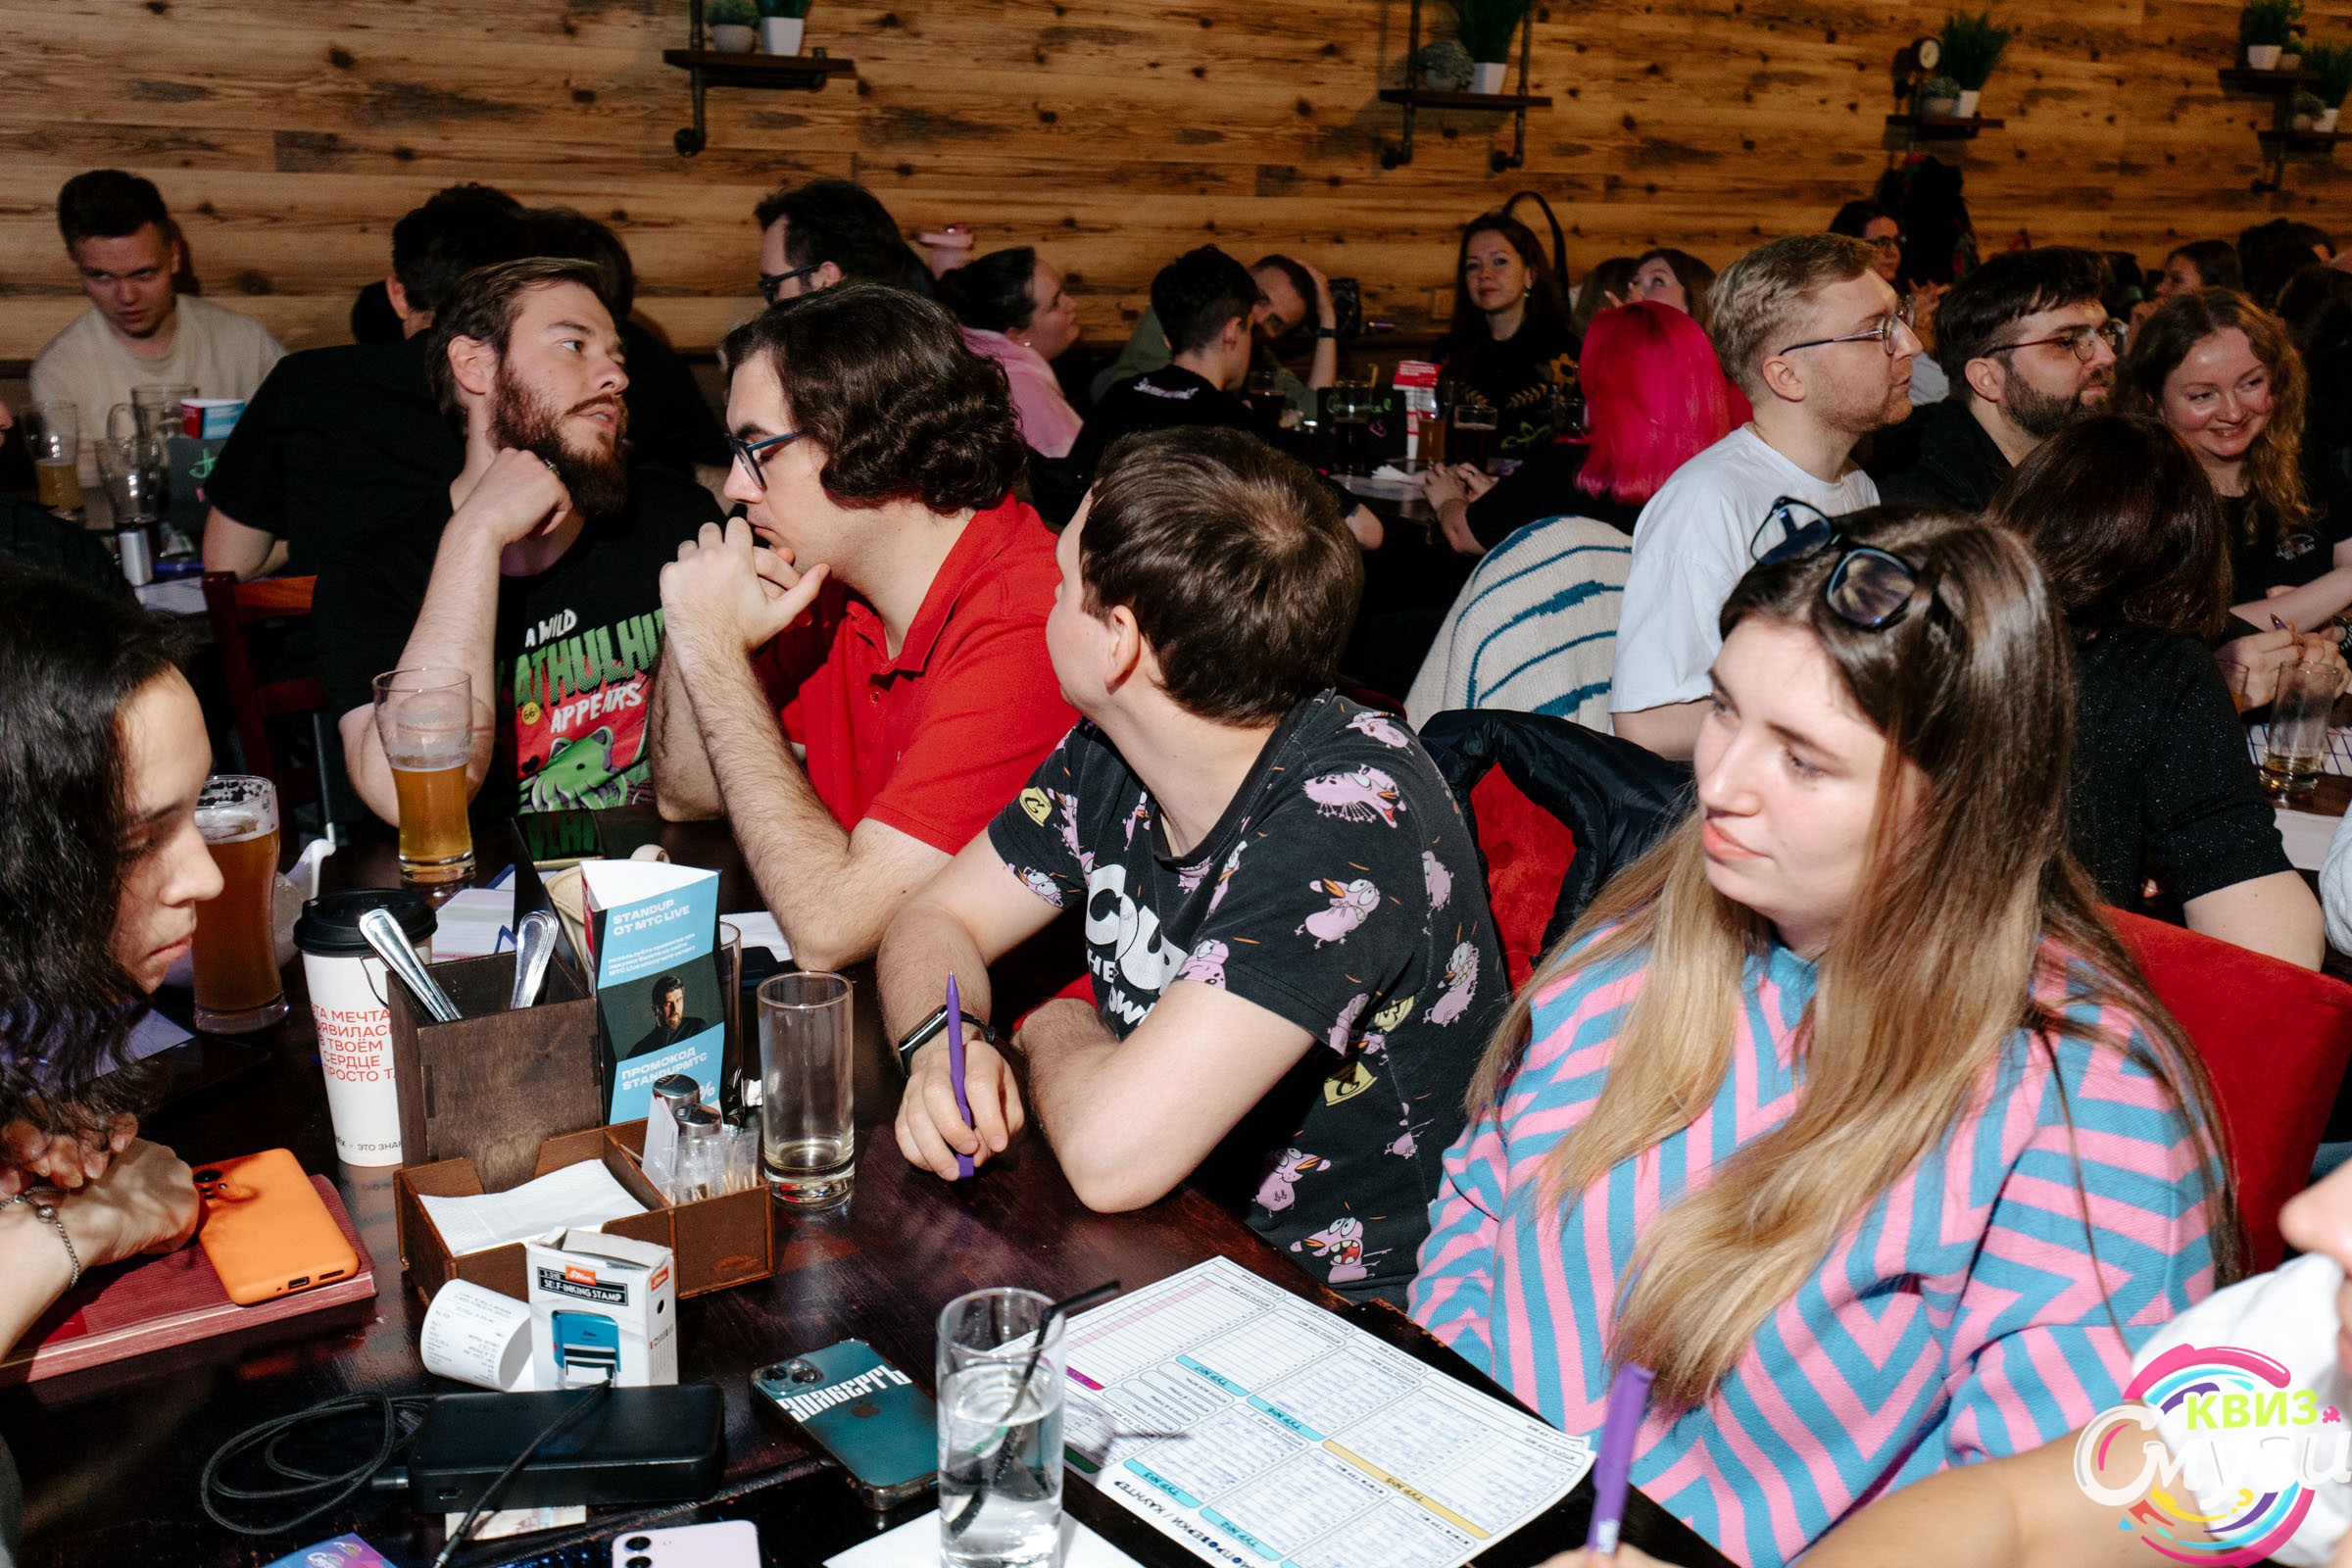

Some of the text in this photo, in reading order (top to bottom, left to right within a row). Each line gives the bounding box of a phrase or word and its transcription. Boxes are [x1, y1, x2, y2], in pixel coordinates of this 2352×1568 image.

[525, 609, 577, 647] A WILD
[550, 683, 642, 733] APPEARS
[612, 899, 674, 924] STANDUP
[613, 922, 633, 936] ОТ
[664, 905, 690, 921] LIVE
[1087, 949, 1116, 984] HE
[331, 1009, 390, 1023] МЕЧТА
[328, 1039, 383, 1053] ТВОЁМ
[323, 1051, 380, 1070] СЕРДЦЕ
[621, 1046, 696, 1080] ПРОМОКОД
[323, 1064, 379, 1082] ПРОСТО
[544, 1279, 622, 1302] SELF-INKING STAMP
[1208, 1373, 1229, 1385] ТУР
[1280, 1416, 1303, 1429] ТУР
[1113, 1480, 1166, 1514] КАУНТЕР
[1157, 1482, 1180, 1495] ТУР
[1402, 1488, 1425, 1500] ТУР
[1237, 1533, 1259, 1547] ТУР
